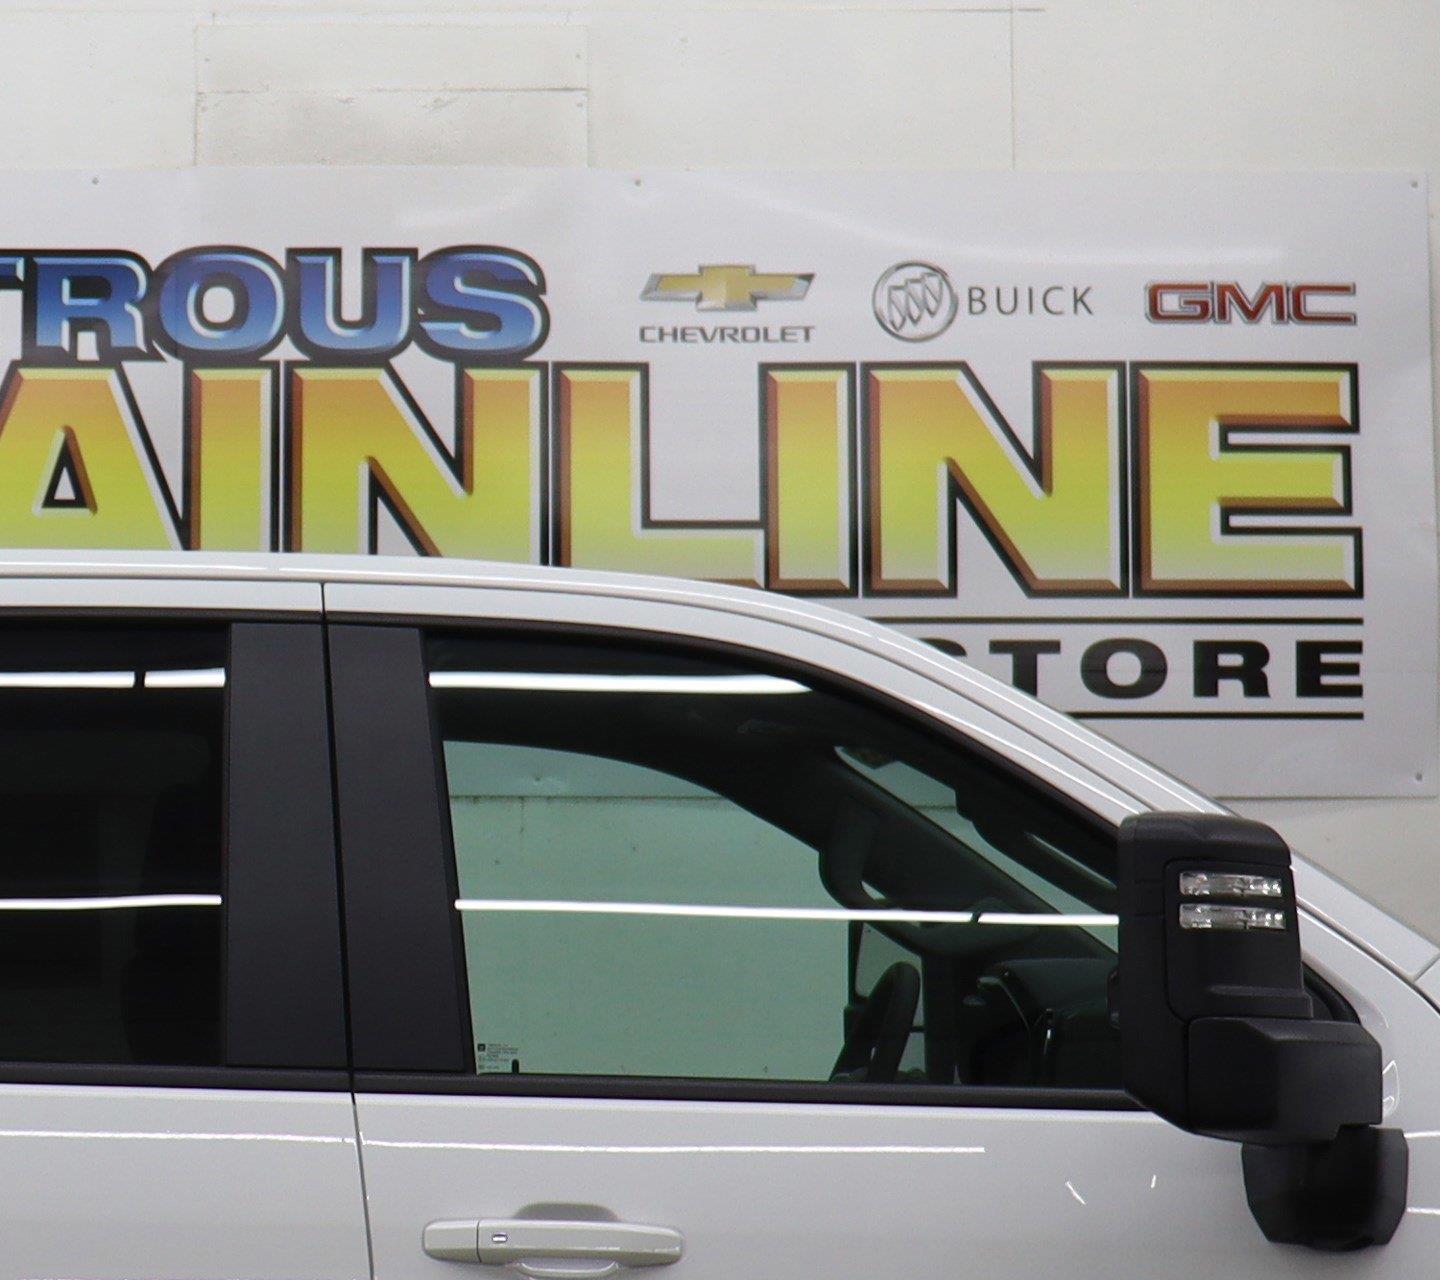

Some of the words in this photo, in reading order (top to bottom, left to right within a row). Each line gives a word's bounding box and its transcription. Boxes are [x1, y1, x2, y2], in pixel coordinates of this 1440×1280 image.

[967, 285, 1095, 316] BUICK
[1145, 280, 1357, 325] GMC
[639, 325, 816, 344] CHEVROLET
[919, 637, 1364, 700] TORE
